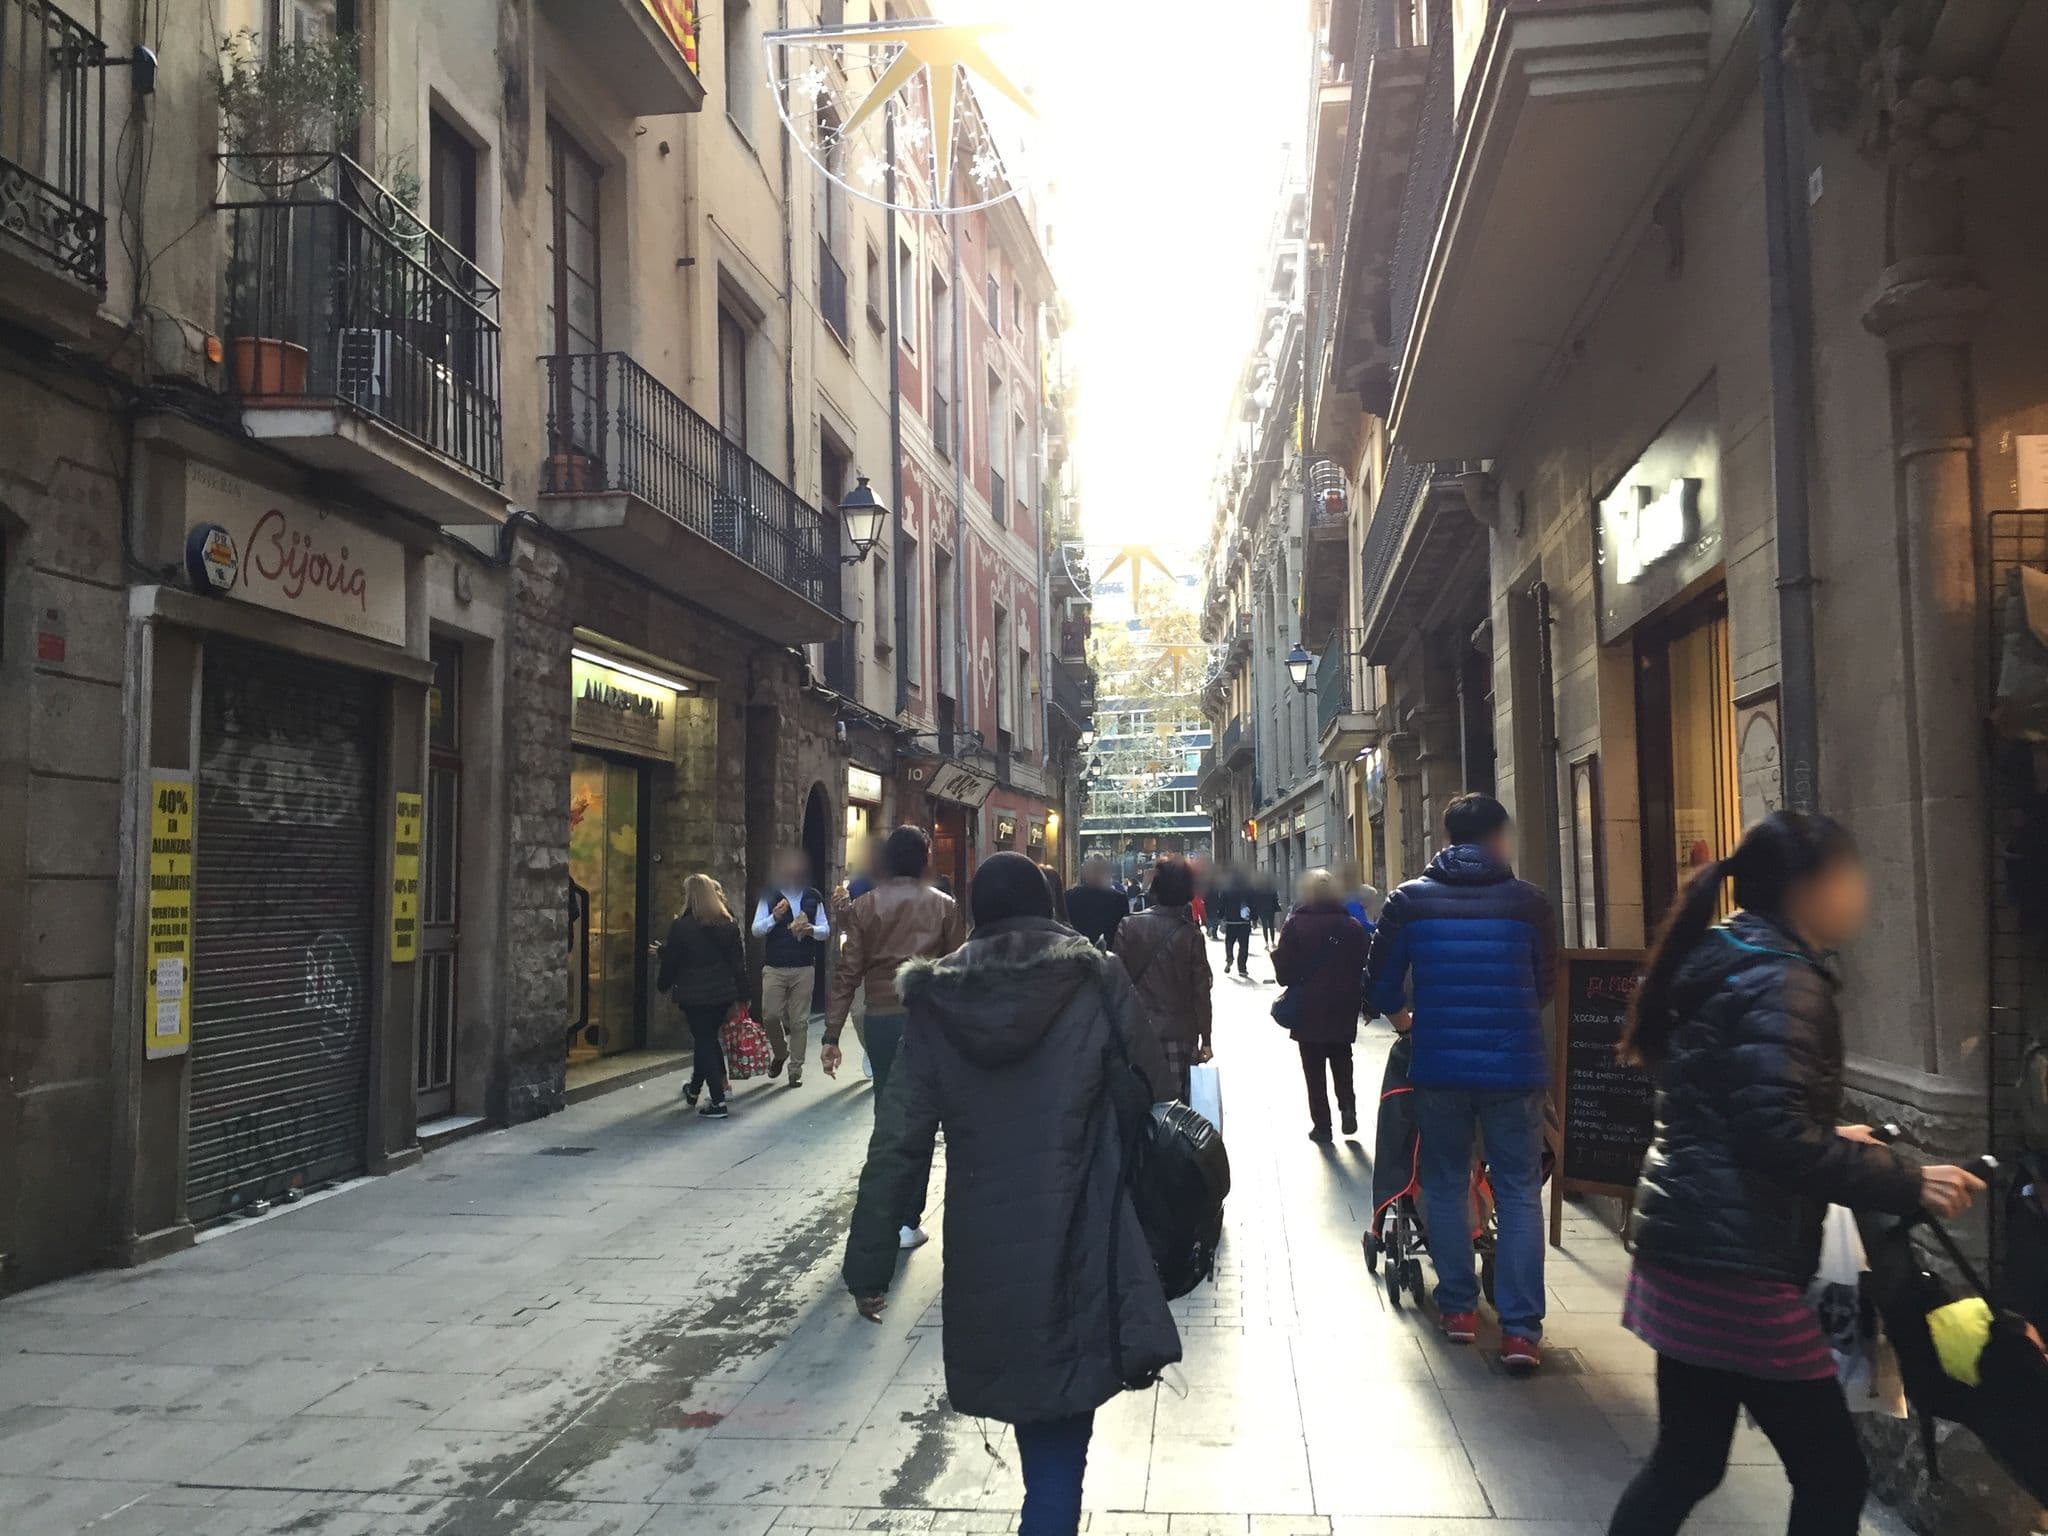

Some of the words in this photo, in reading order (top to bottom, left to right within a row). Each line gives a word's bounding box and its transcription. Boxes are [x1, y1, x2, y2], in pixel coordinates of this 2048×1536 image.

[243, 508, 367, 613] Bijoria
[907, 768, 924, 781] 10
[158, 789, 189, 815] 40%
[151, 838, 191, 854] ALIANZAS
[151, 925, 171, 936] PLATA
[154, 941, 184, 953] INTERIOR
